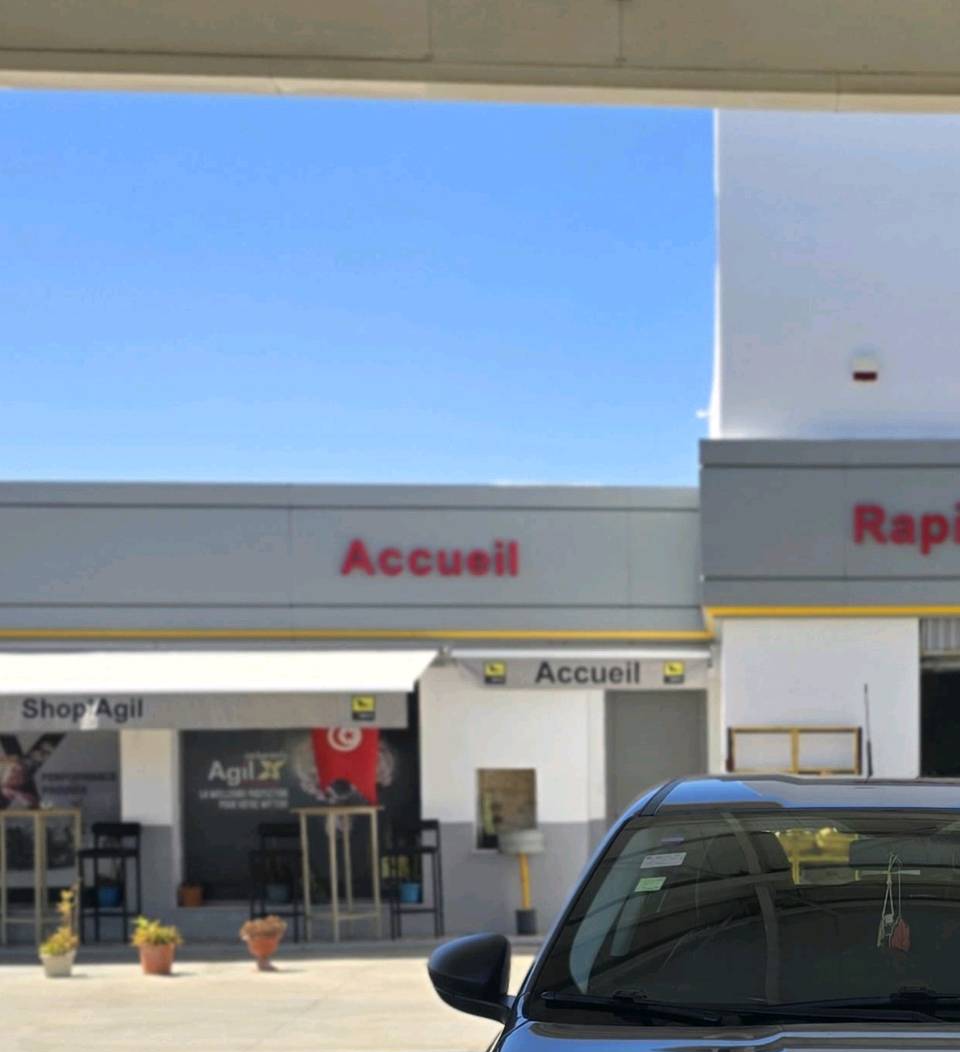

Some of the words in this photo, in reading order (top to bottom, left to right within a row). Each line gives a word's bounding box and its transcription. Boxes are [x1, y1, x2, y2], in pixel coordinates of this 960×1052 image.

[341, 539, 519, 577] Accueil
[534, 662, 640, 684] Accueil
[207, 760, 255, 786] Agil
